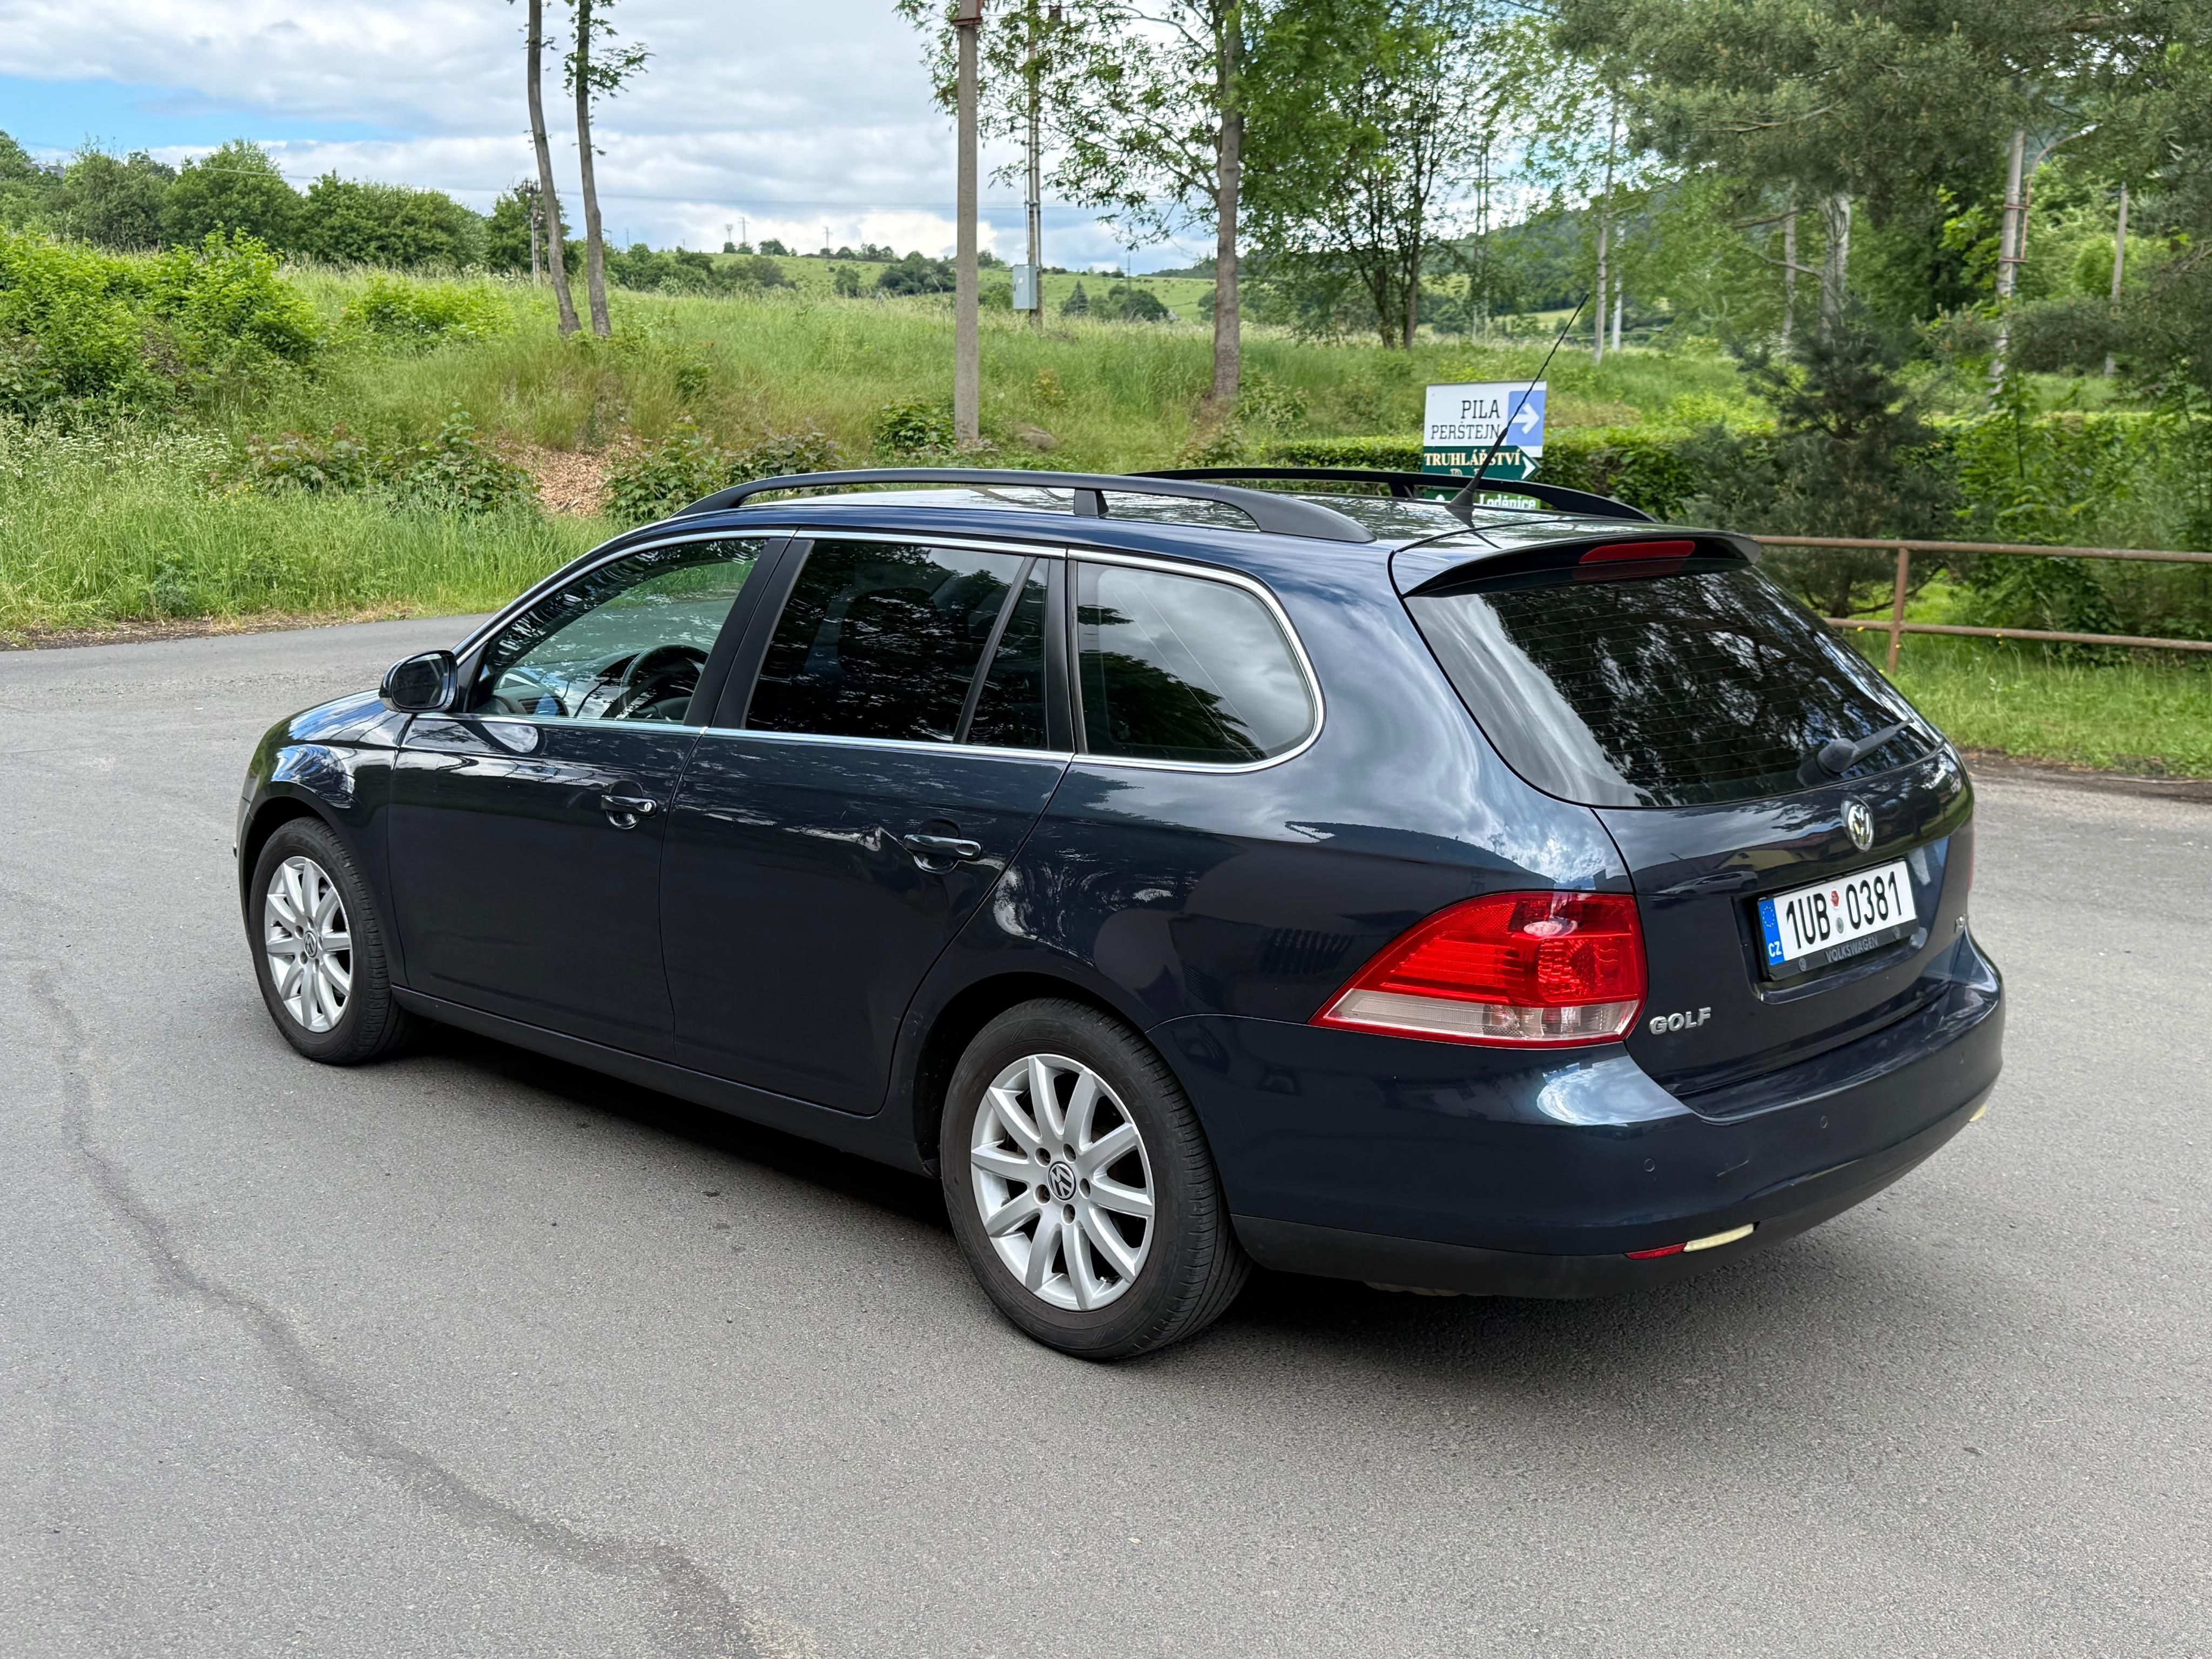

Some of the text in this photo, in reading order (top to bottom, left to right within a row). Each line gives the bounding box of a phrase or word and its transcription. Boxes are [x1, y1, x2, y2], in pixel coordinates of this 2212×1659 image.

[1460, 400, 1500, 419] PILA
[1431, 421, 1501, 440] PERŠTEJN
[1785, 871, 1902, 949] 1UB 0381
[1768, 941, 1782, 958] CZ
[1824, 935, 1878, 963] VOLKSWAGEN
[1649, 1007, 1711, 1035] GOLF
